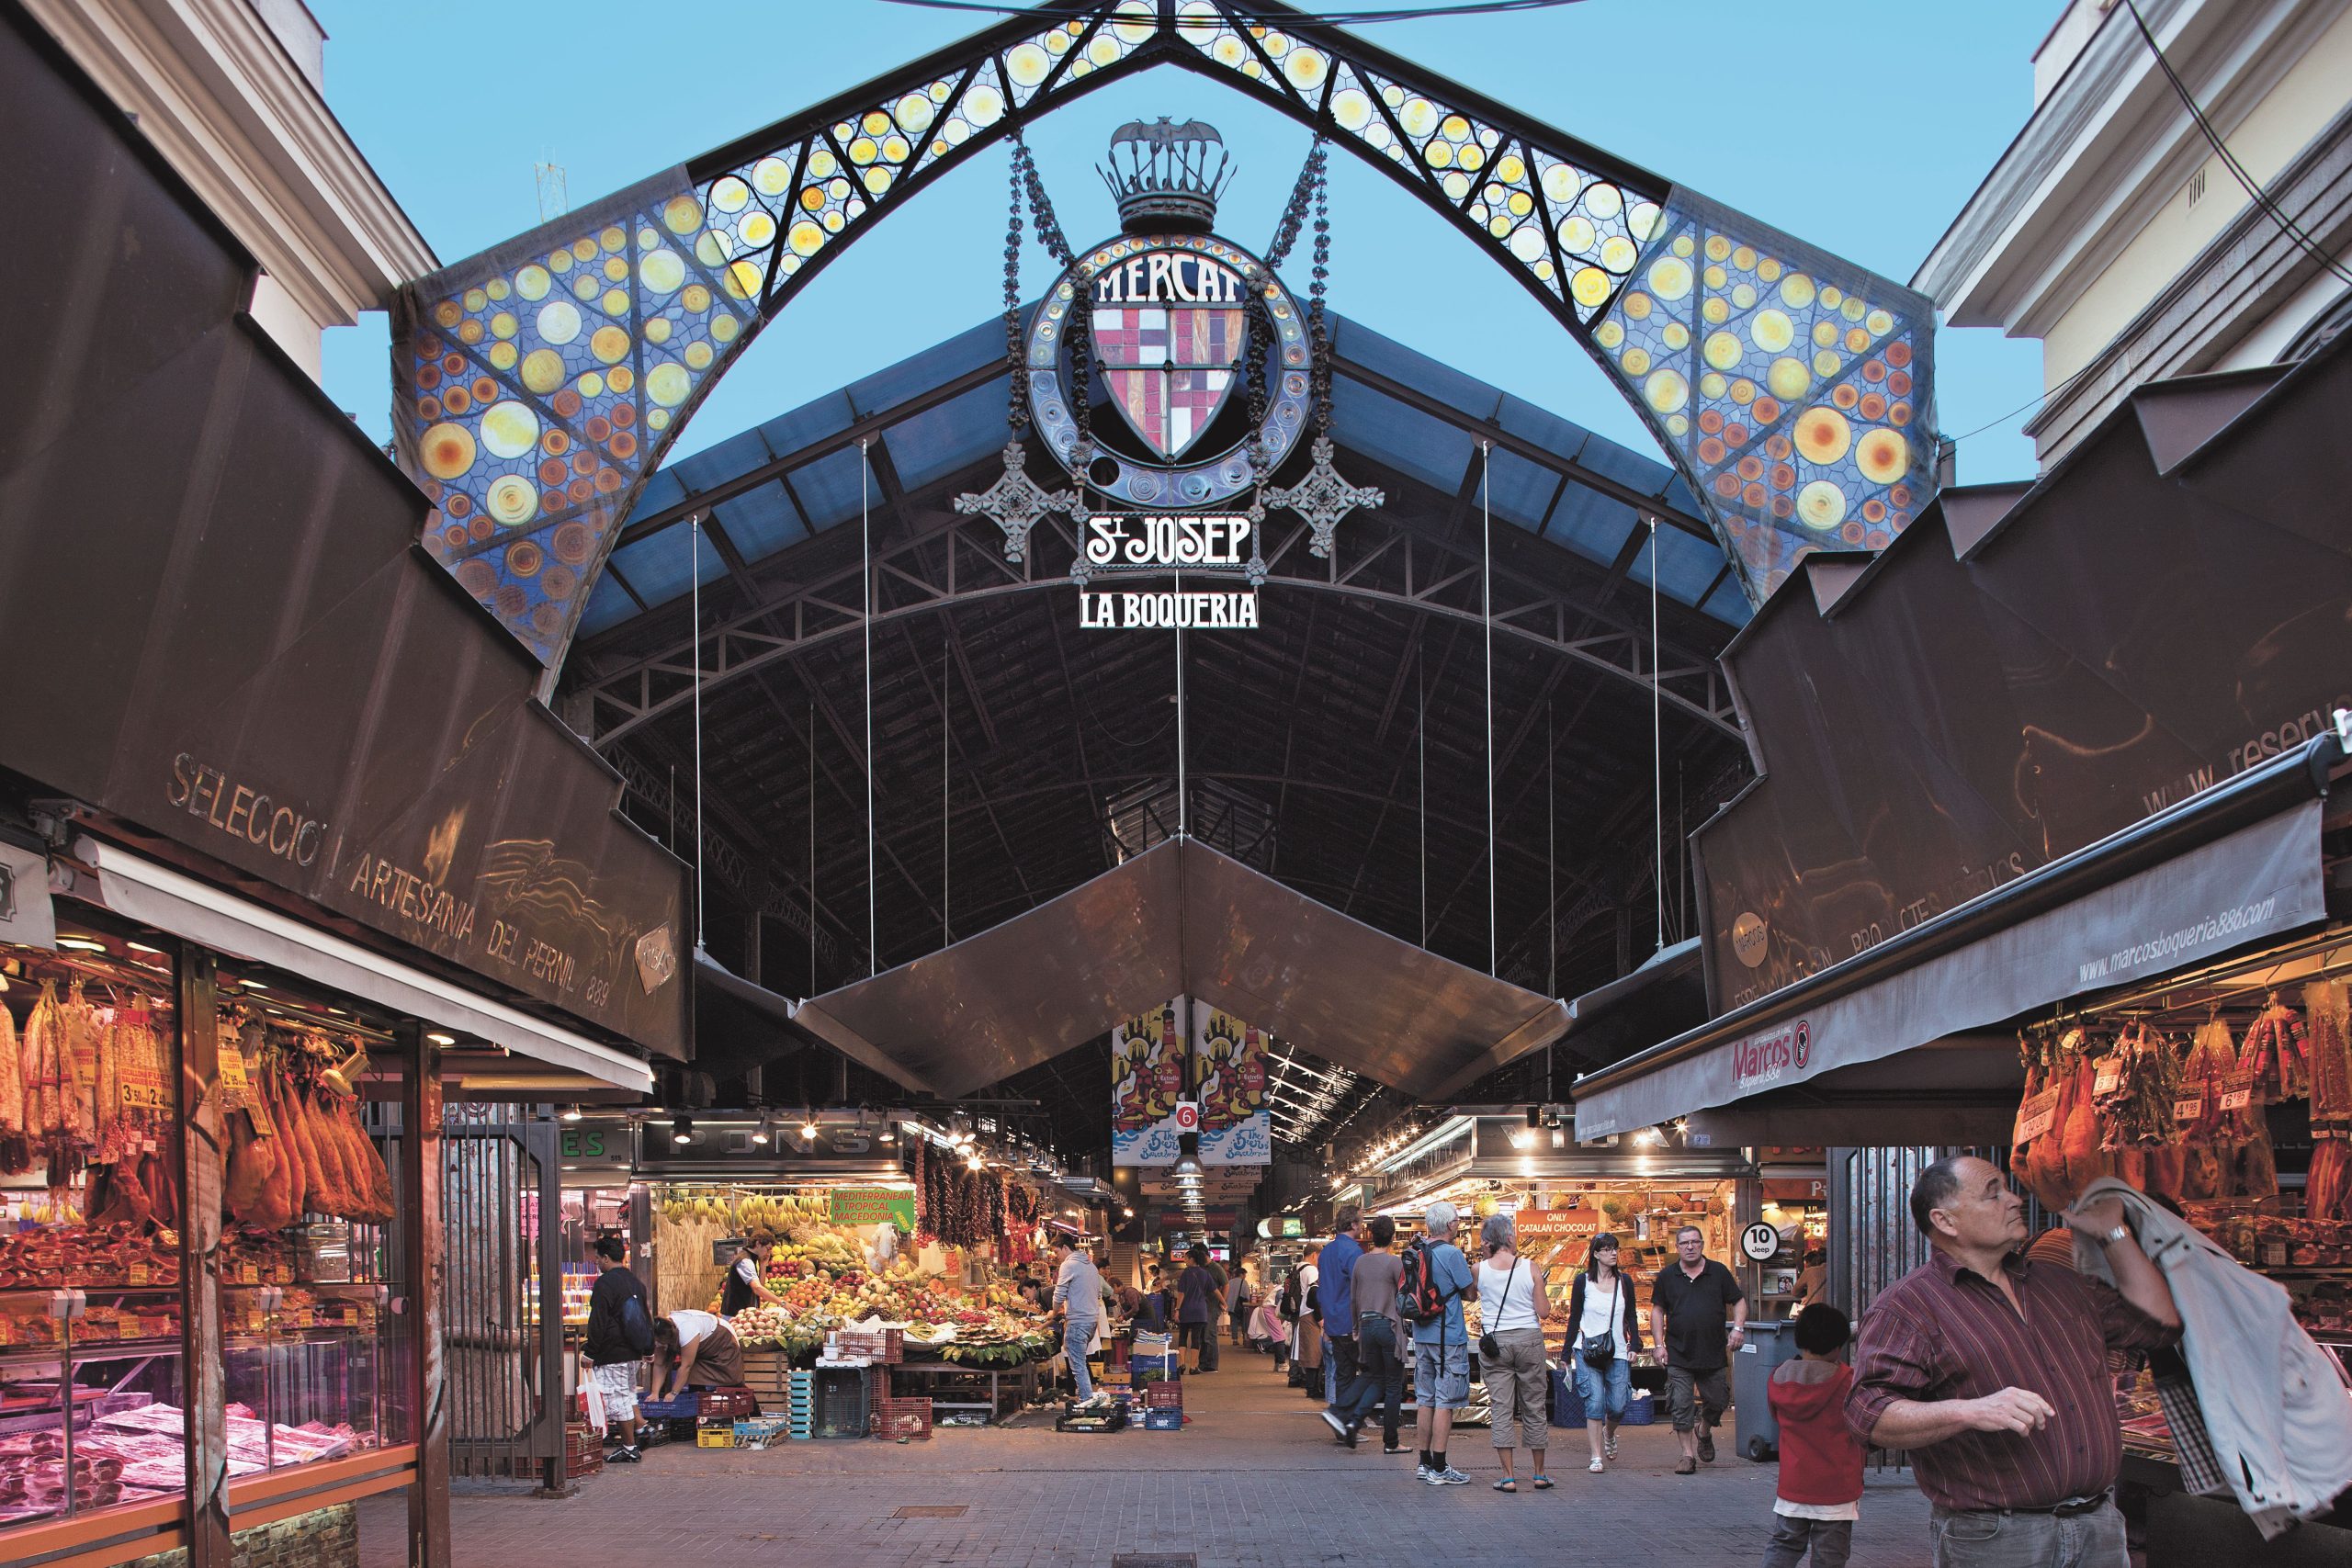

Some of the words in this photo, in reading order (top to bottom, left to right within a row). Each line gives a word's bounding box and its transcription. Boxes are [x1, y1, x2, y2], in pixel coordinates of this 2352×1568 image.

[1098, 254, 1240, 302] MERCAT
[1125, 517, 1250, 564] JOSEP
[1080, 593, 1115, 627] LA
[1123, 593, 1258, 628] BOQUERIA
[350, 852, 476, 946] ARTESANIA
[486, 919, 519, 966] DEL
[522, 937, 576, 993] PERNIL
[586, 976, 609, 1007] 889
[1736, 925, 1765, 955] MARCOS
[1732, 1035, 1791, 1082] Marcos
[1182, 1110, 1192, 1123] 6
[669, 1128, 870, 1154] PONS
[1140, 1147, 1181, 1159] Barcelon
[833, 1191, 912, 1201] MEDITERRANEAN
[834, 1202, 841, 1211] &
[844, 1201, 889, 1211] TROPICAL
[833, 1212, 894, 1221] MACEDONIA
[1546, 1213, 1567, 1223] ONLY
[1518, 1224, 1553, 1233] CATALAN
[1554, 1223, 1597, 1233] CHOCOLAT
[1750, 1228, 1770, 1244] 10
[1751, 1246, 1770, 1254] Jeep
